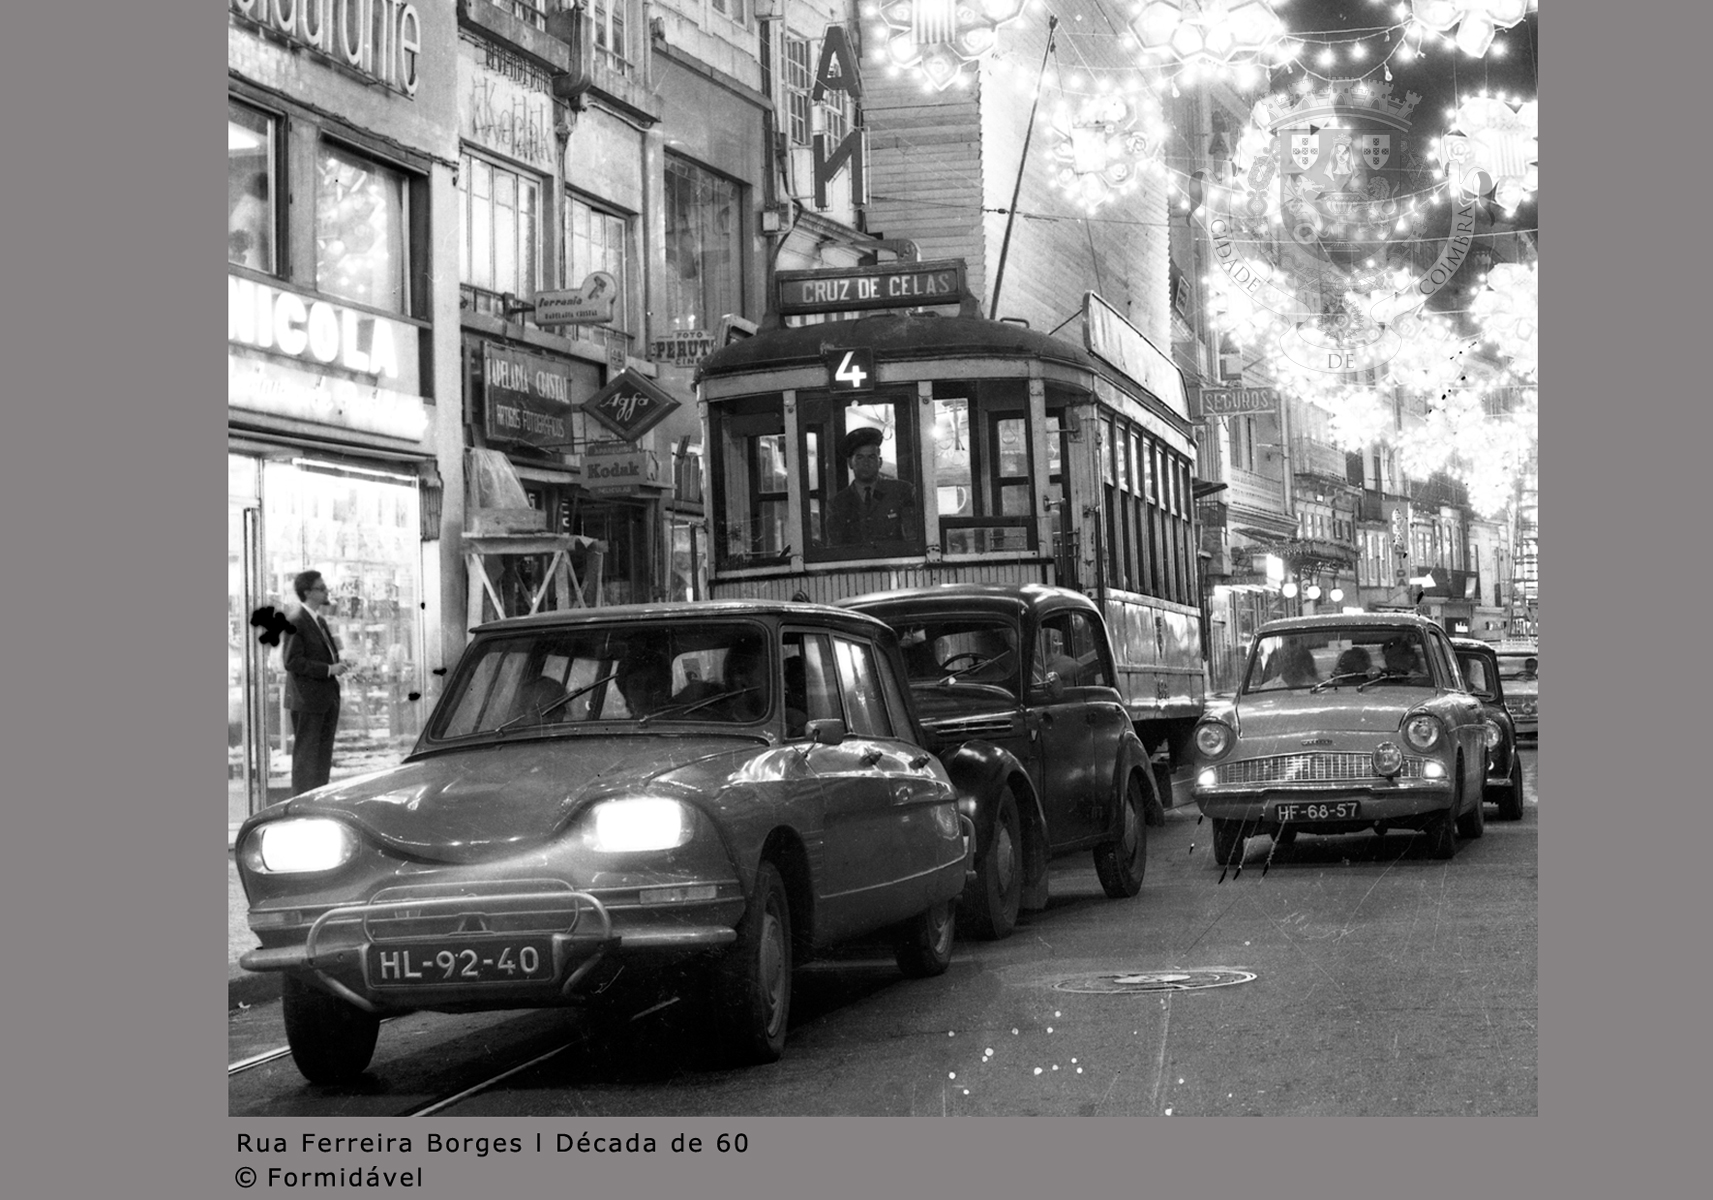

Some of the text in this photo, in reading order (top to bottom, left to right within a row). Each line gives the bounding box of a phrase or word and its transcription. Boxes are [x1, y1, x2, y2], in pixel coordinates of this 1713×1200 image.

[802, 274, 950, 303] CRUZ DE CELAS
[228, 275, 398, 379] NICOLA
[835, 351, 867, 388] 4
[536, 371, 570, 404] CRISTAL
[600, 392, 649, 421] Agfa
[587, 461, 639, 479] Kodak
[1278, 803, 1357, 820] HF-68-57
[380, 946, 539, 979] HL-92-40
